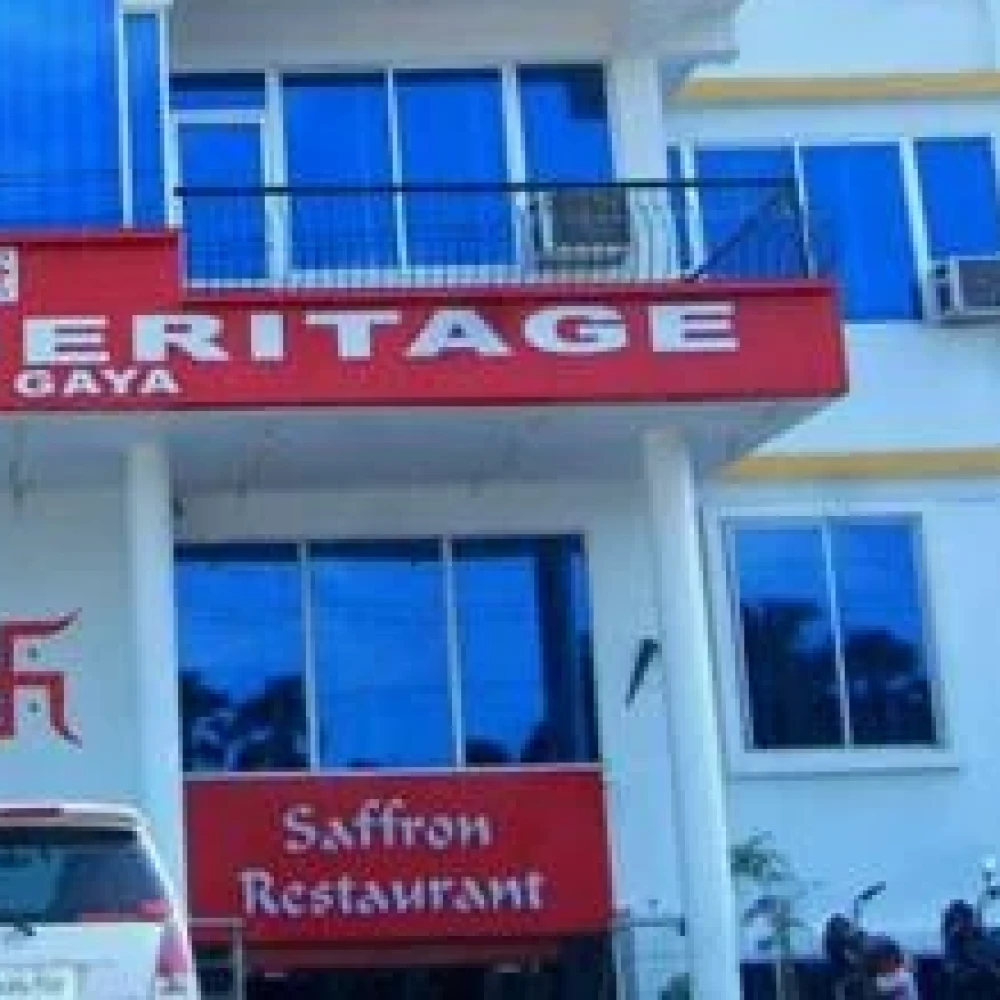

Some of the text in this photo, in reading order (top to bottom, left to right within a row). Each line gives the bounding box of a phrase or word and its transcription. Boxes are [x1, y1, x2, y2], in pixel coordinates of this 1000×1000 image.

[15, 367, 181, 398] GAYA
[283, 798, 493, 852] Saffron
[239, 868, 545, 917] Restaurant
